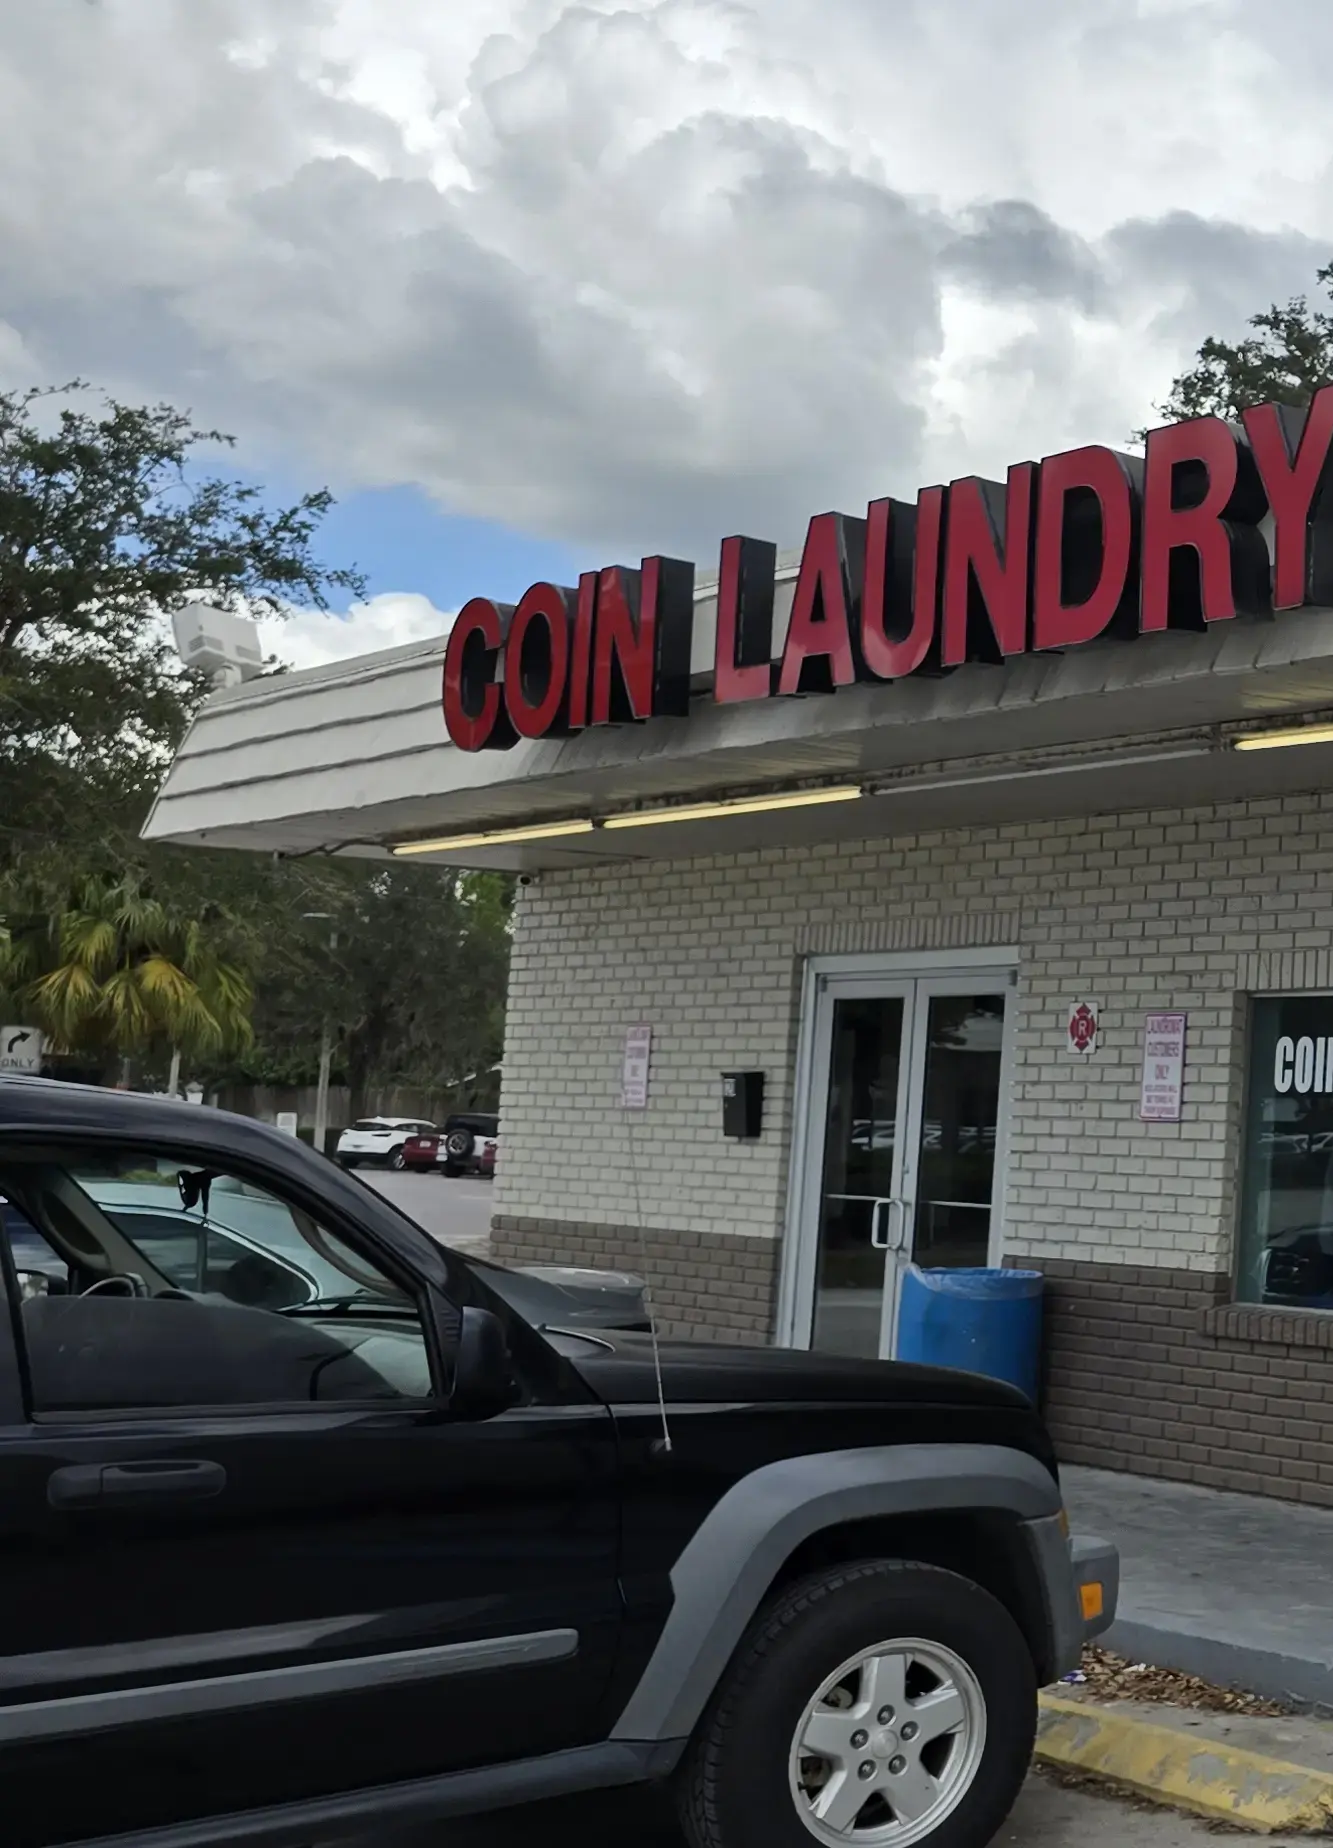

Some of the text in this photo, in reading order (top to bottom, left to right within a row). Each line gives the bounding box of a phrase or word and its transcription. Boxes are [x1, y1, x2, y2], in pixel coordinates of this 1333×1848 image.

[442, 554, 664, 753] COIN
[1079, 1020, 1087, 1036] R
[1, 1058, 35, 1068] ONLY
